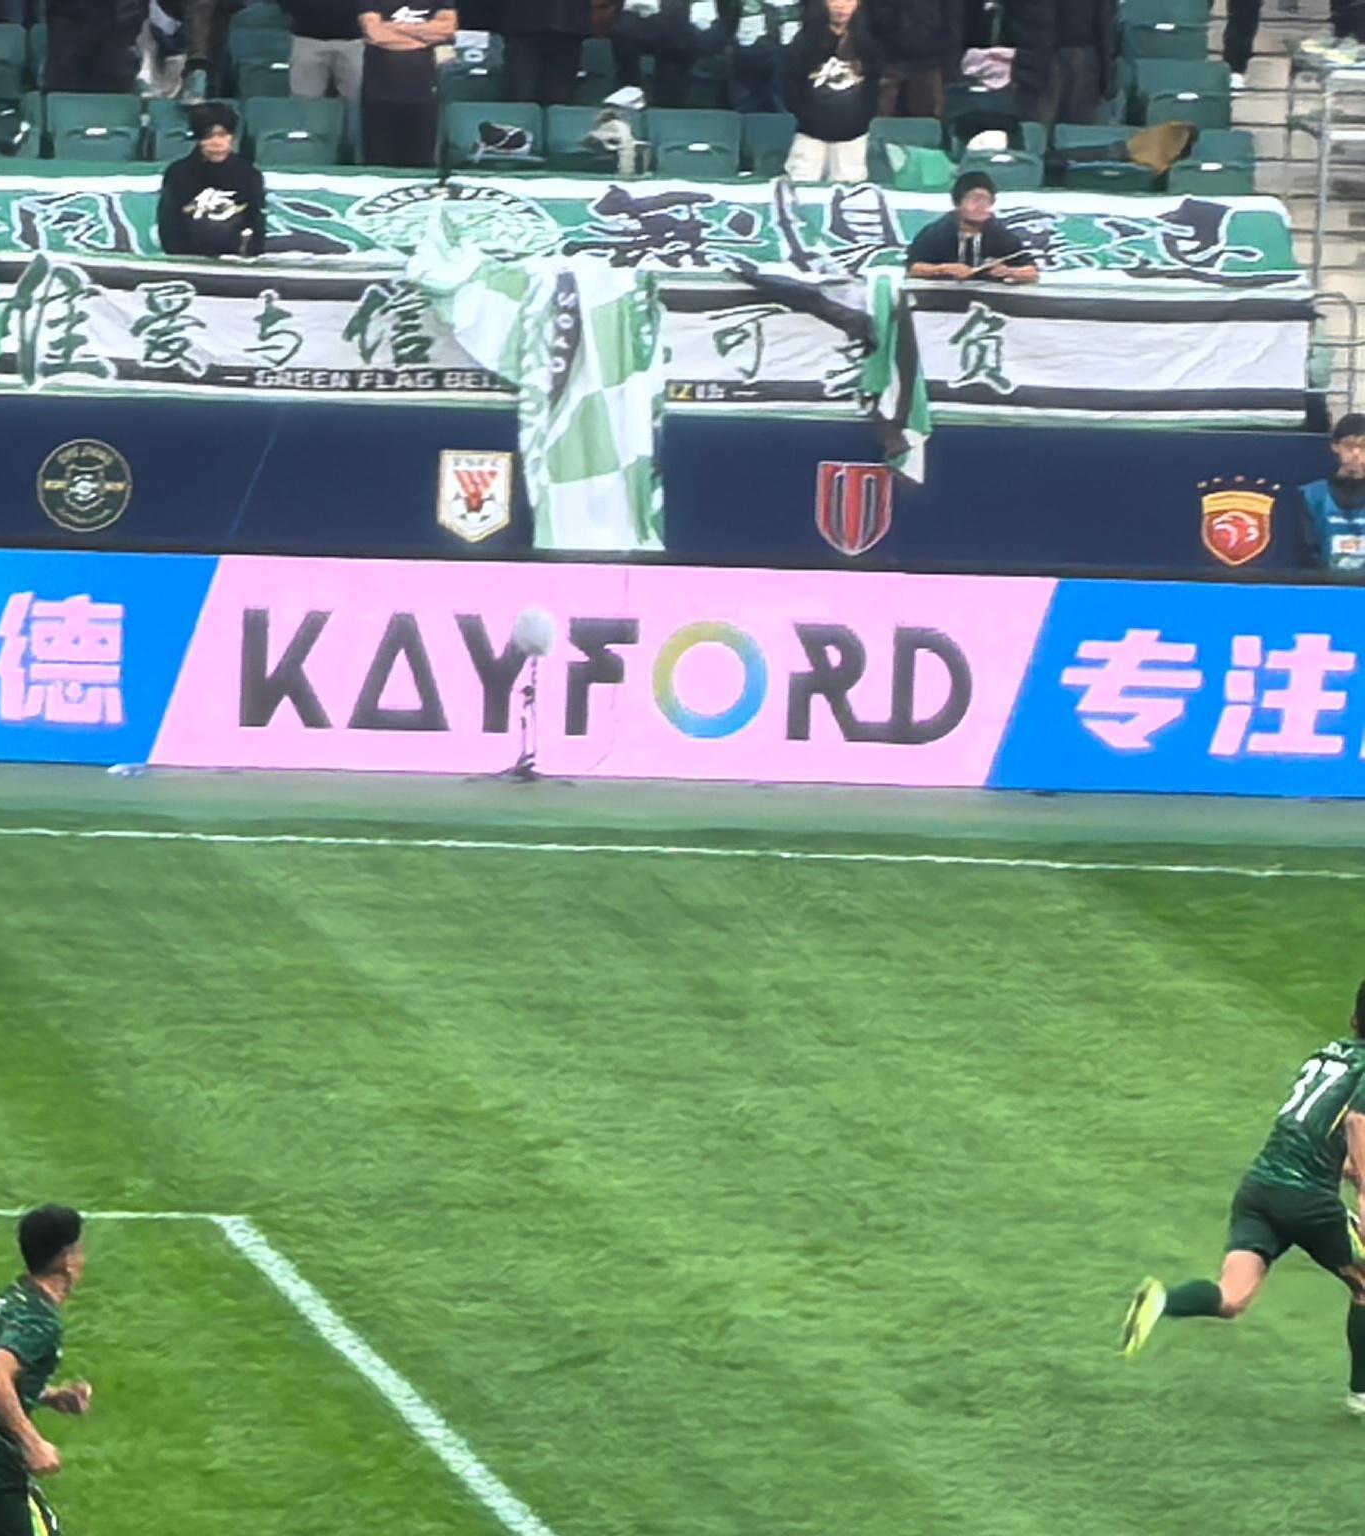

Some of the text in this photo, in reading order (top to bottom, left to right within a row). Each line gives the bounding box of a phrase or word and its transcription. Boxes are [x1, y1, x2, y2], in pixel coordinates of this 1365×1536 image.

[254, 370, 350, 389] GREEN
[357, 371, 436, 390] FLAG
[240, 606, 973, 744] KAYFORD
[1061, 629, 1365, 759] 专注
[1278, 1058, 1348, 1122] 37
